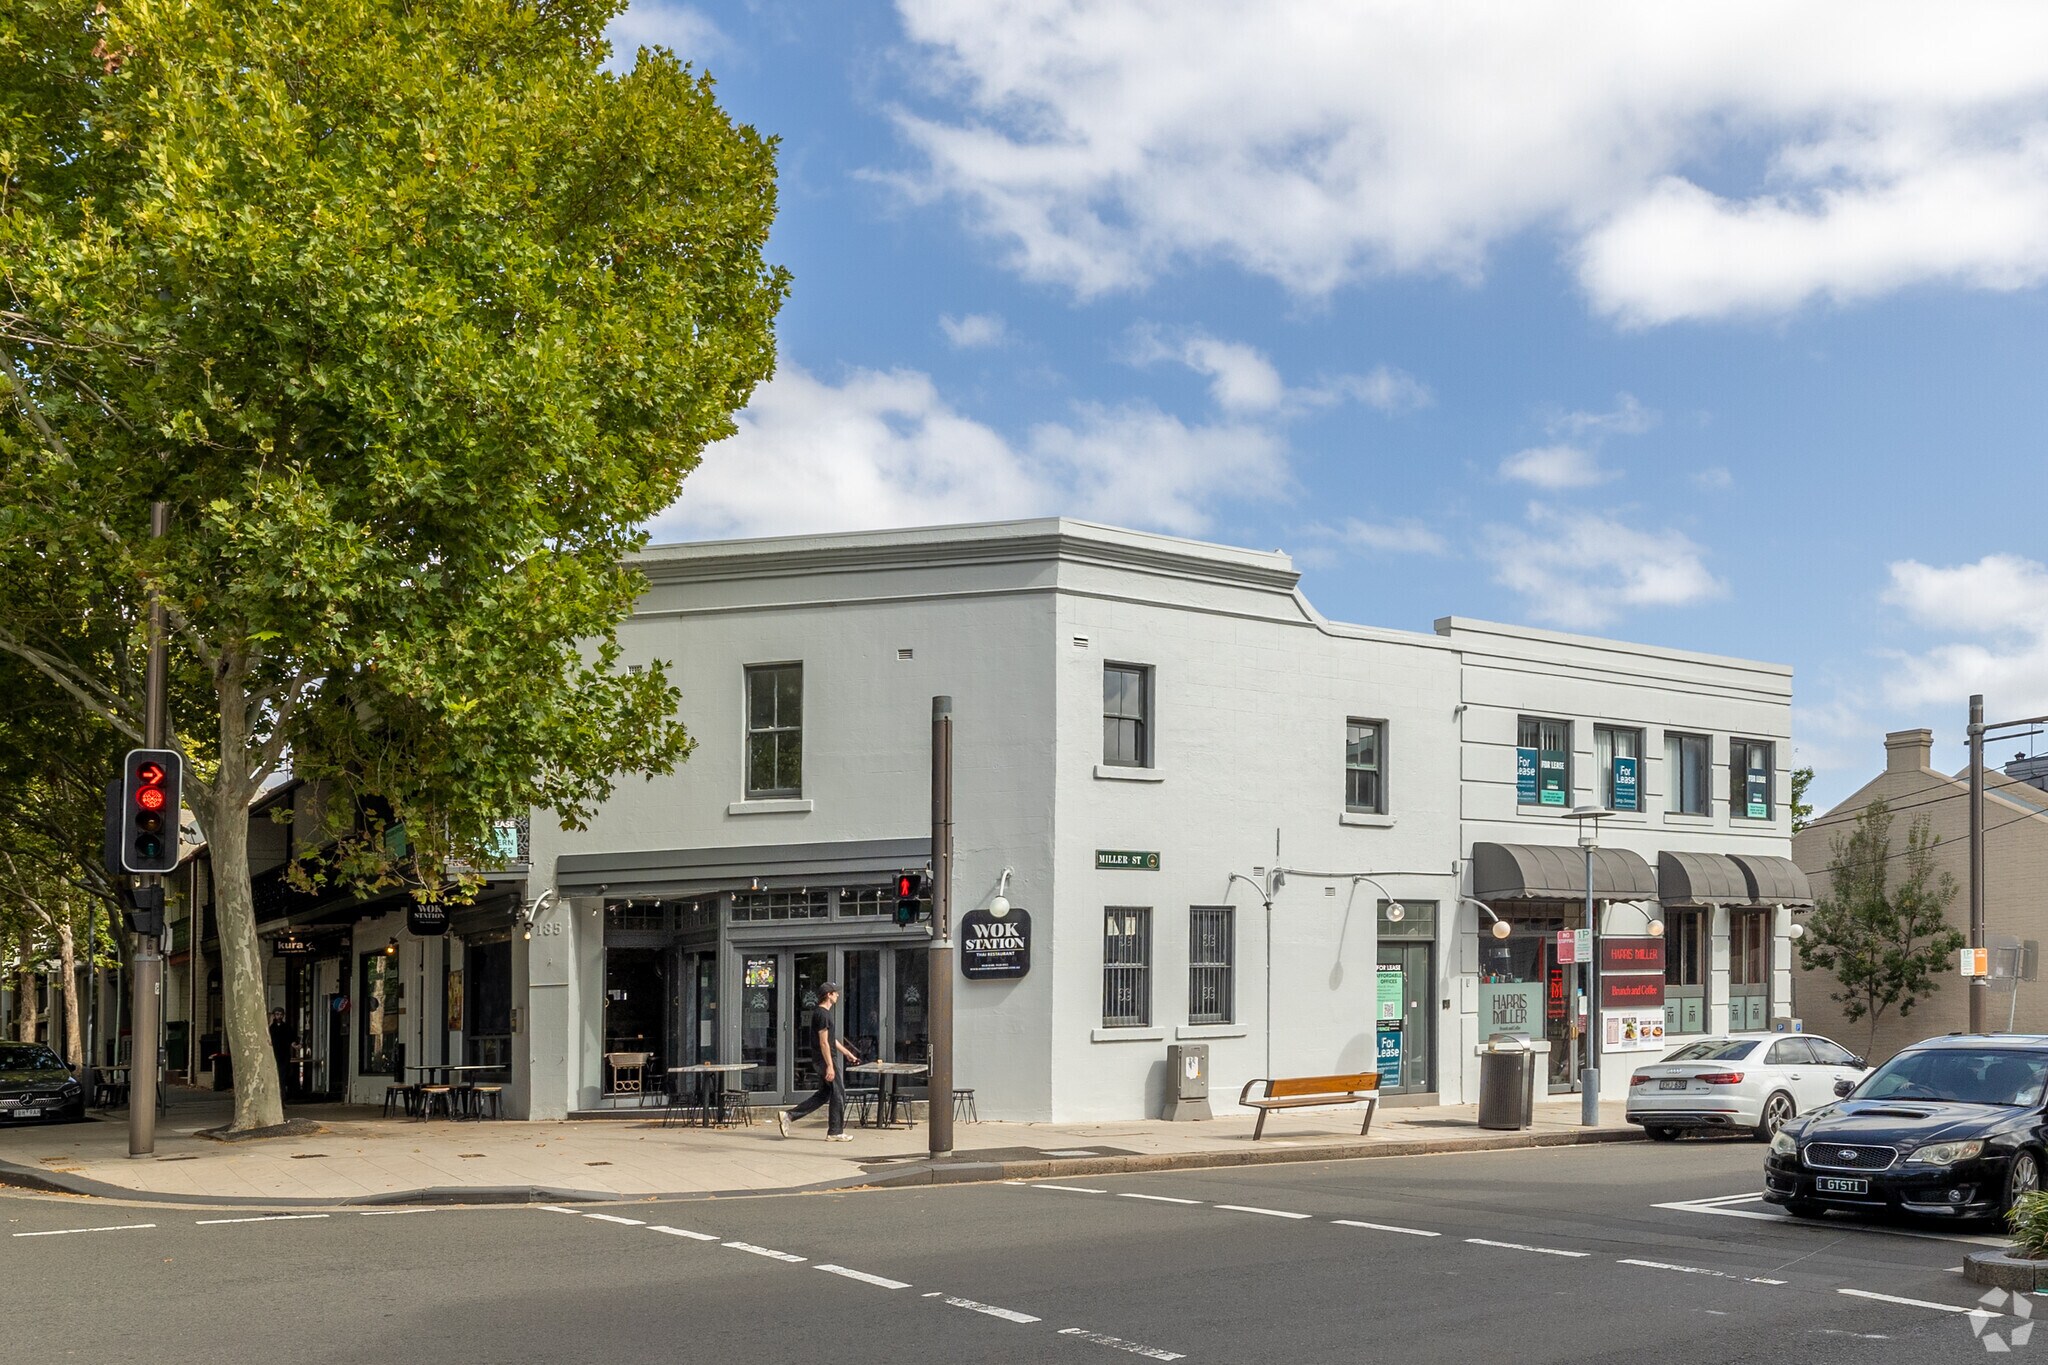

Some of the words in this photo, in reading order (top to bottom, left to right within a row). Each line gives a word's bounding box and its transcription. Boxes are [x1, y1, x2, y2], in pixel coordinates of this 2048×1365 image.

[1518, 756, 1531, 767] For
[1541, 760, 1551, 769] FOR
[1551, 761, 1565, 770] LEASE
[1620, 765, 1632, 776] For
[1616, 773, 1635, 785] Lease
[494, 820, 516, 828] EASE
[1098, 854, 1129, 864] MILLER
[1131, 855, 1142, 865] ST
[417, 904, 442, 913] WOK
[972, 922, 1020, 938] WOK
[1577, 930, 1590, 939] 1P
[277, 940, 304, 950] kura
[965, 937, 1026, 951] STATION
[1611, 948, 1633, 960] HARRIS
[1634, 948, 1658, 960] MILLER
[1641, 984, 1658, 996] Coffee
[1492, 993, 1528, 1010] HARRIS
[1492, 1009, 1528, 1025] MILLER
[1381, 1036, 1396, 1049] For
[1376, 1046, 1400, 1058] Lease
